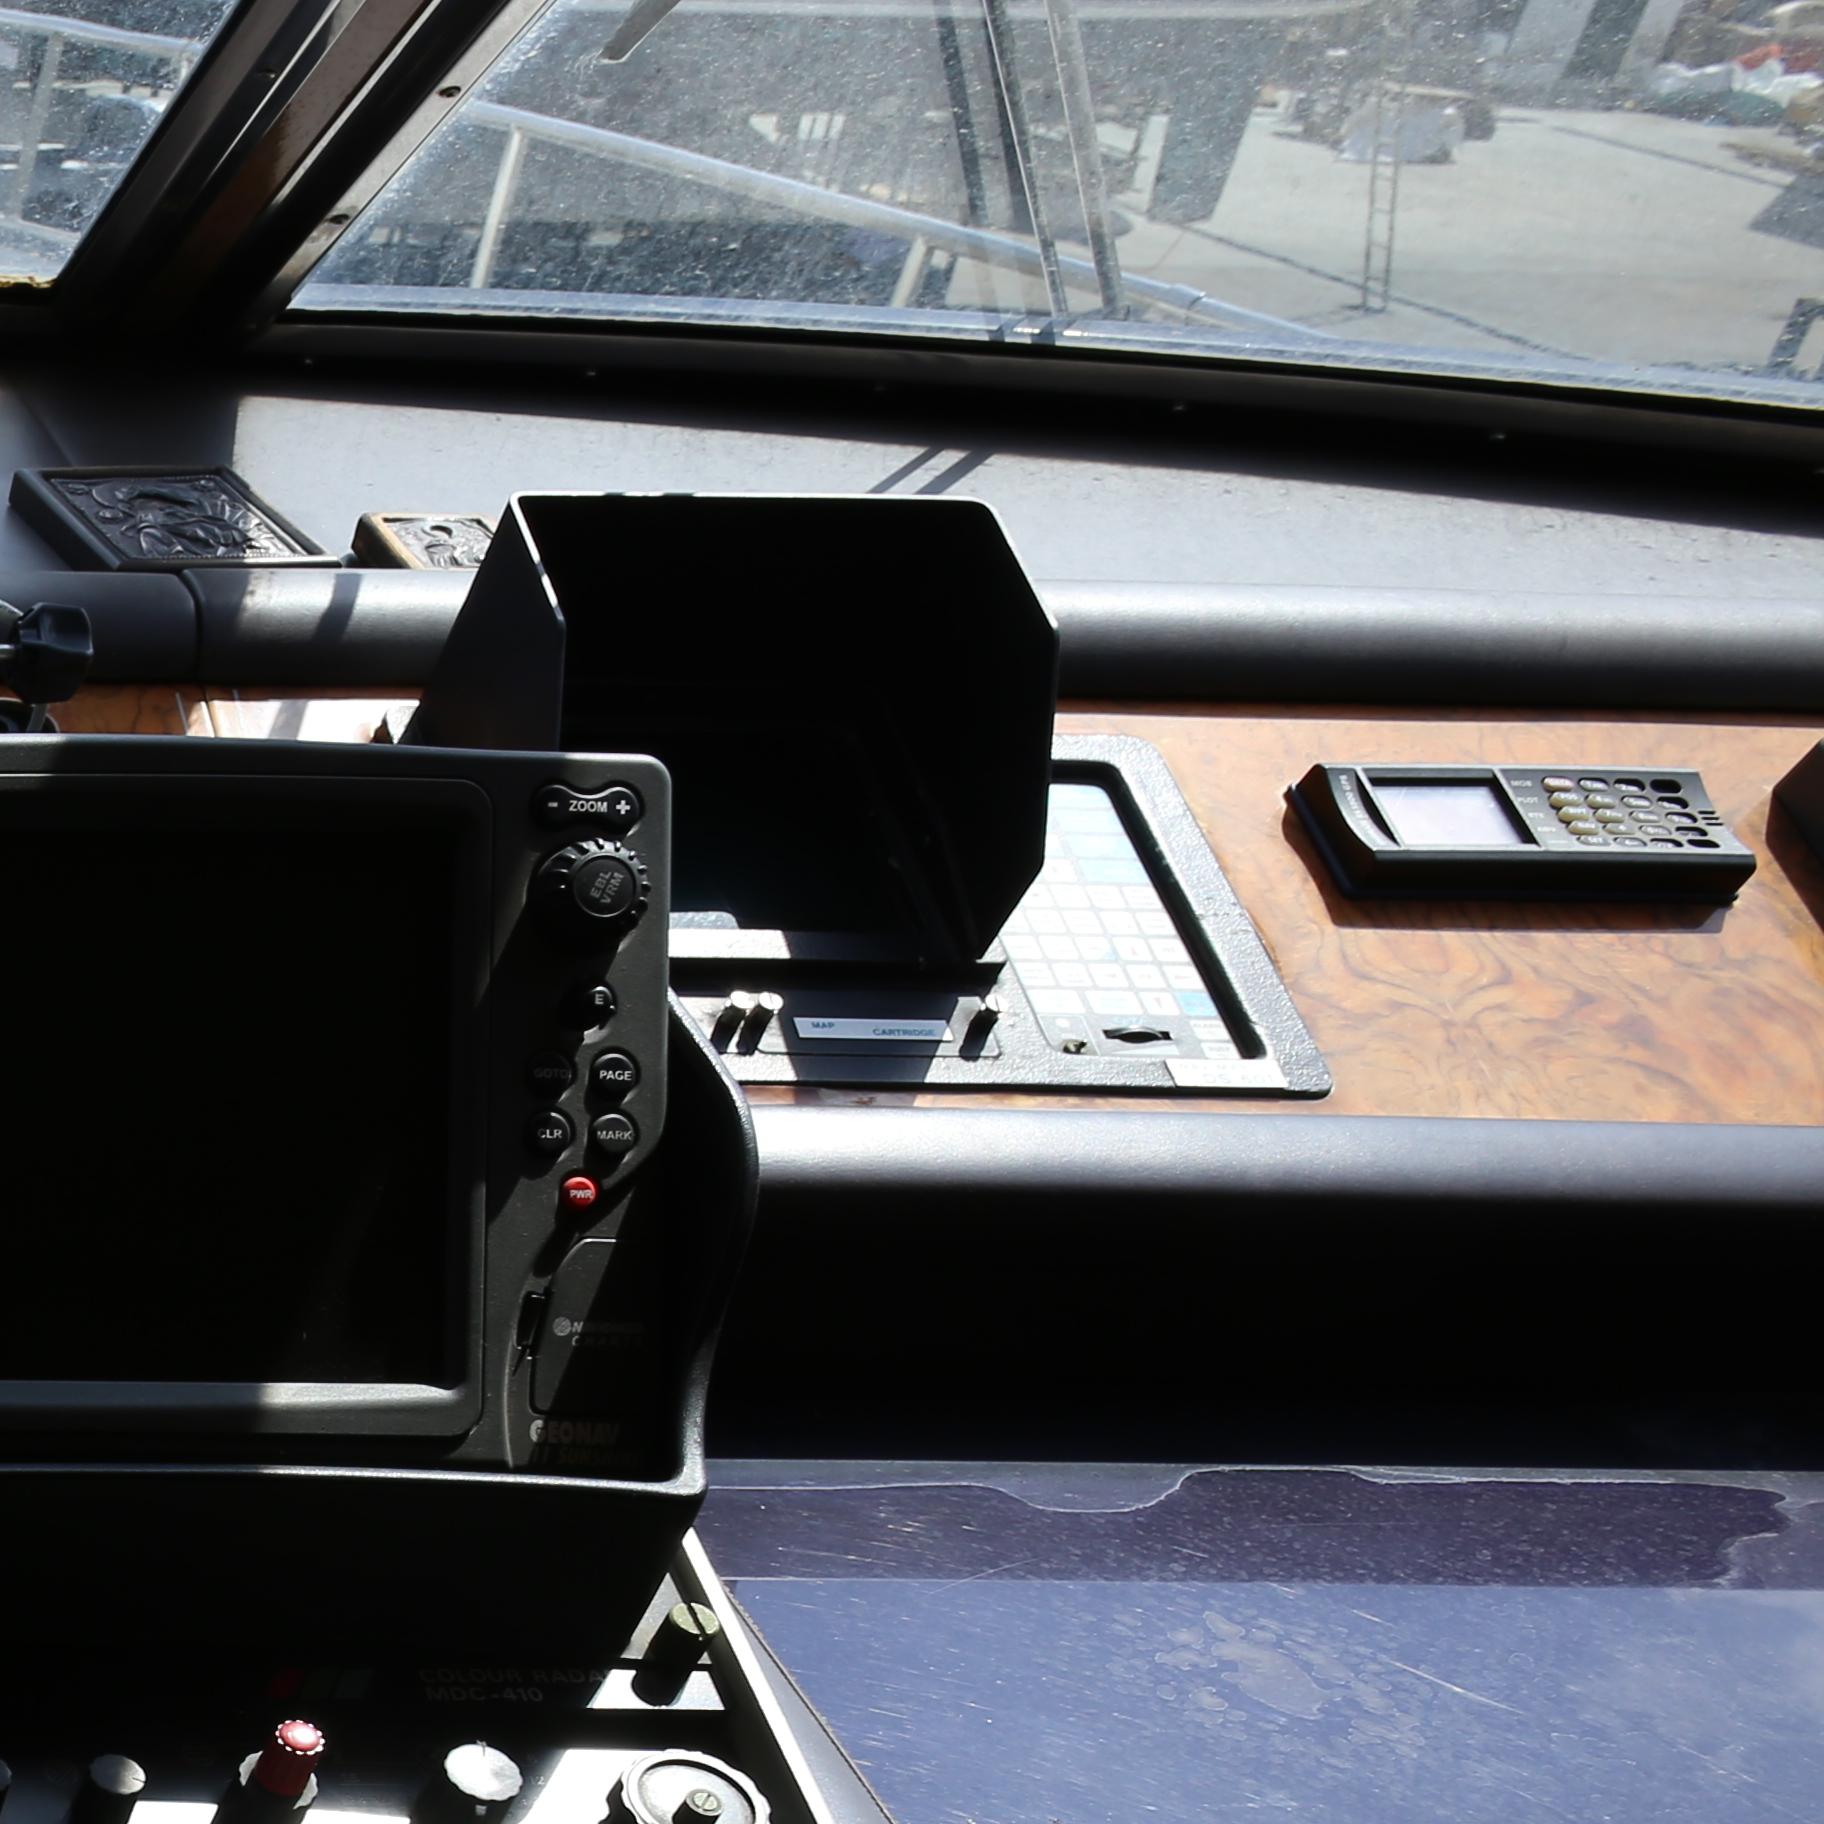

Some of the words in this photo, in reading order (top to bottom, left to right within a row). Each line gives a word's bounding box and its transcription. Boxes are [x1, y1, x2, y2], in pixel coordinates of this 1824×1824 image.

[568, 800, 608, 813] ZOOM
[589, 871, 612, 900] EBL
[600, 872, 625, 904] VRM
[811, 1021, 835, 1029] MAP
[872, 1028, 936, 1036] CARTRIDGE
[533, 1068, 569, 1079] GOTO
[599, 1070, 633, 1081] PAGE
[537, 1128, 563, 1139] CLR
[596, 1130, 633, 1140] MARK
[569, 1189, 593, 1199] PWR
[529, 1419, 621, 1443] GEONAV
